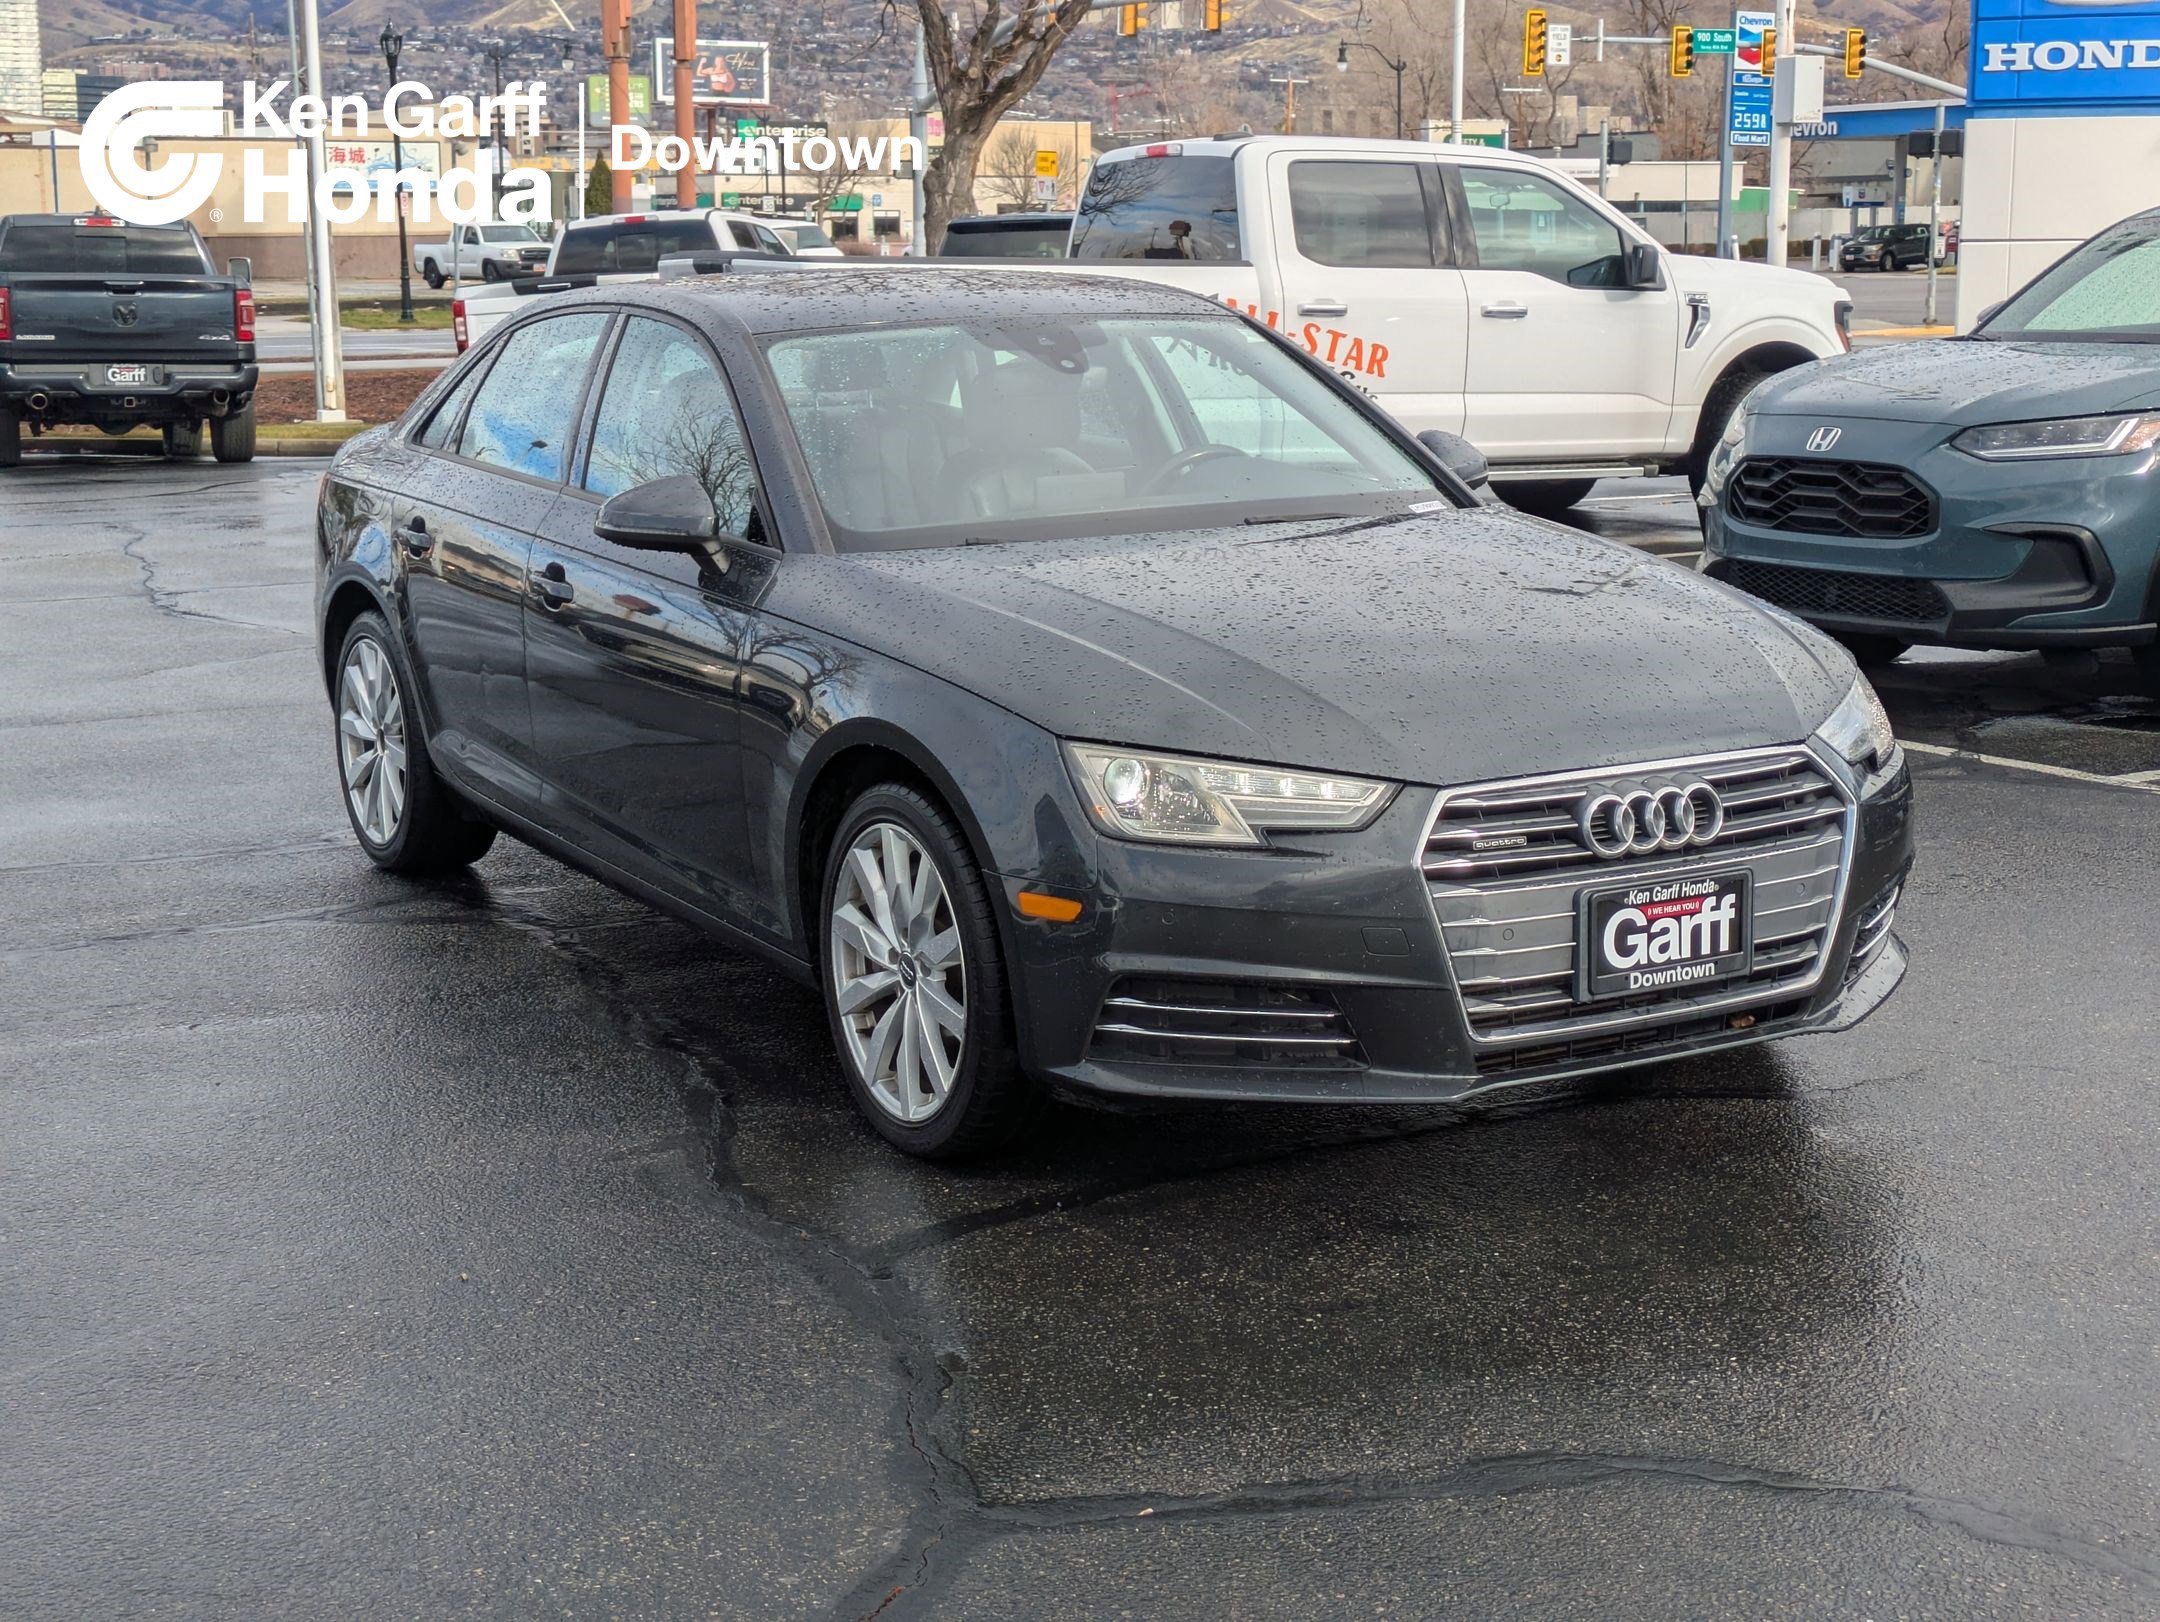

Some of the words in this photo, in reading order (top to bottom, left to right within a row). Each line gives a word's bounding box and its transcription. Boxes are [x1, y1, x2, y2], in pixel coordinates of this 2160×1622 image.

[1739, 15, 1773, 26] Chevron
[1697, 32, 1711, 42] 900
[1713, 32, 1732, 42] South
[1734, 134, 1750, 142] Food
[1751, 135, 1767, 143] Mart
[328, 146, 366, 164] 海城
[107, 367, 146, 382] Garff
[1475, 838, 1525, 849] quattro
[1628, 889, 1650, 906] Ken
[1652, 883, 1680, 902] Garff
[1681, 878, 1715, 898] Honda
[1652, 904, 1663, 914] WE
[1663, 902, 1682, 914] HEAR
[1683, 901, 1695, 911] YOU
[1603, 893, 1736, 969] Garff
[1629, 962, 1715, 990] Downtown
